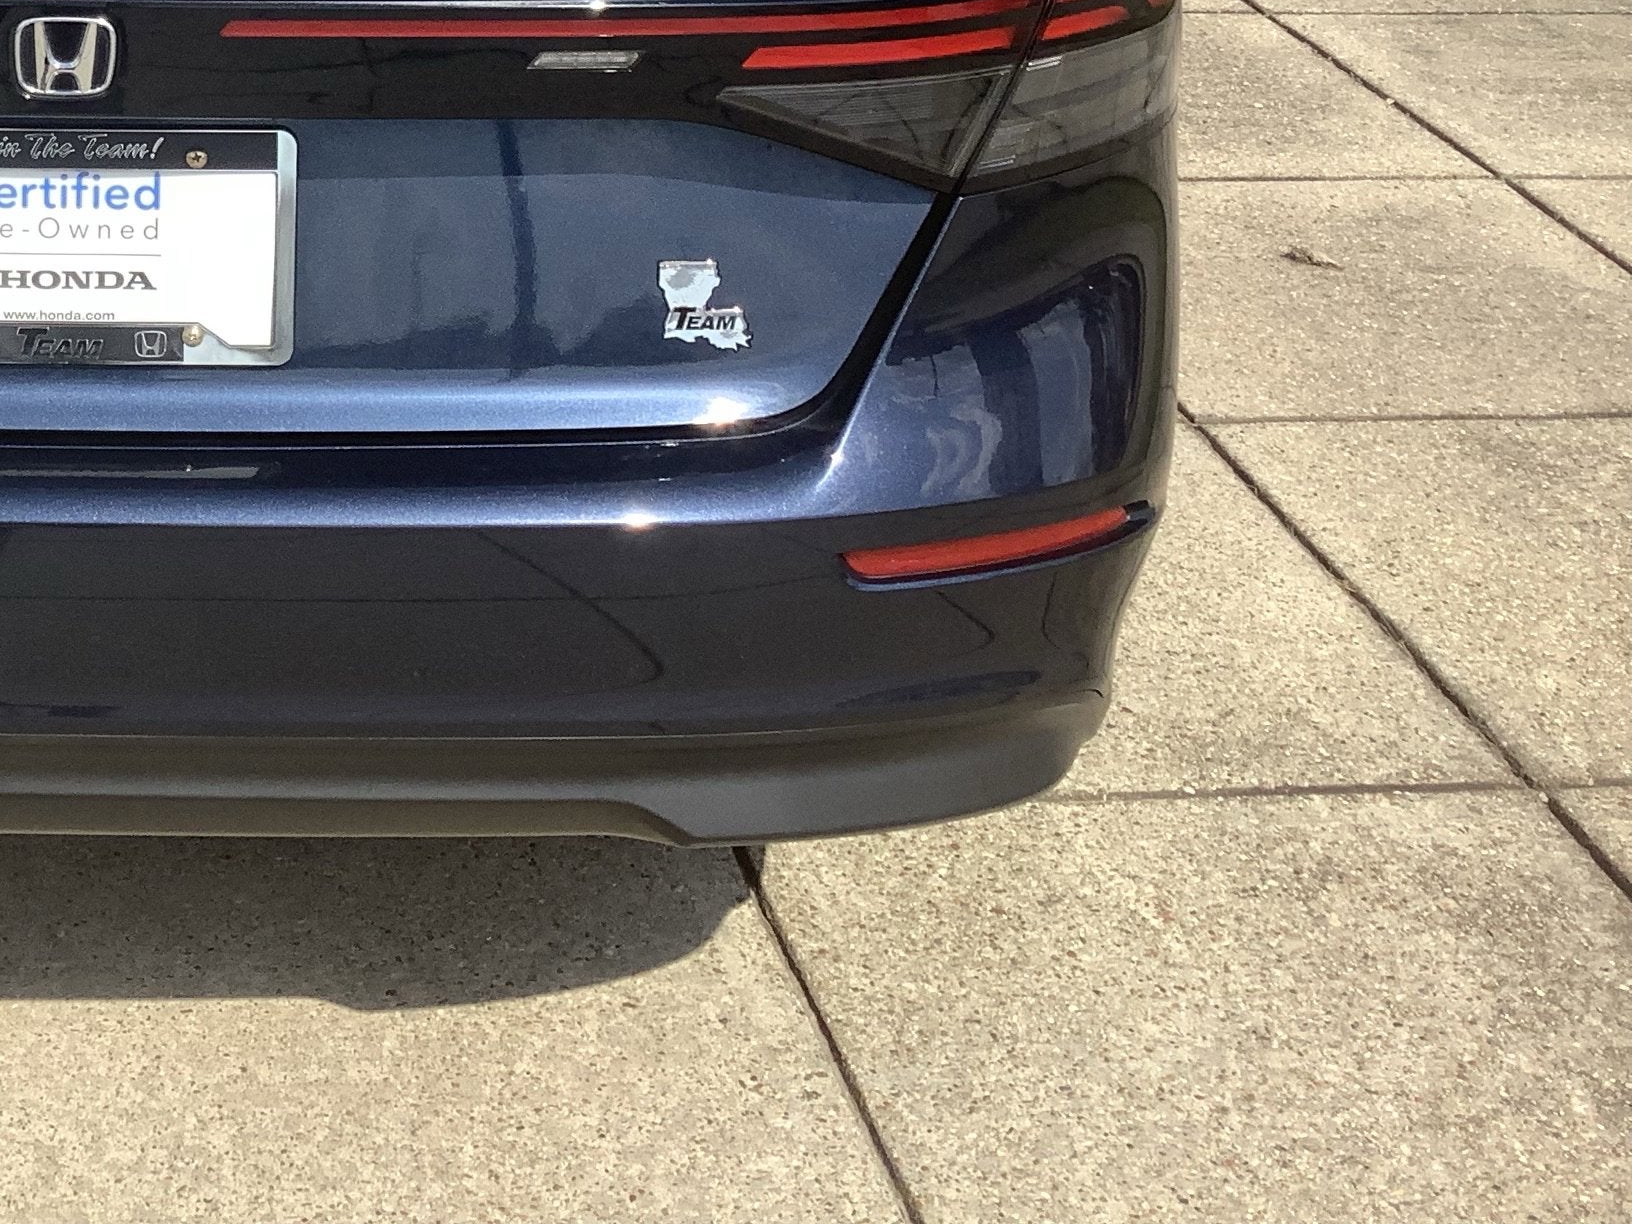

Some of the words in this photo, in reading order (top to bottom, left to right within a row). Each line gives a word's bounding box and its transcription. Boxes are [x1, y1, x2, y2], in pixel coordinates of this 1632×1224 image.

[24, 133, 75, 160] The
[78, 134, 165, 161] Team!
[3, 310, 115, 321] www.honda.com
[672, 306, 737, 330] TEAM
[16, 326, 104, 360] TEAM
